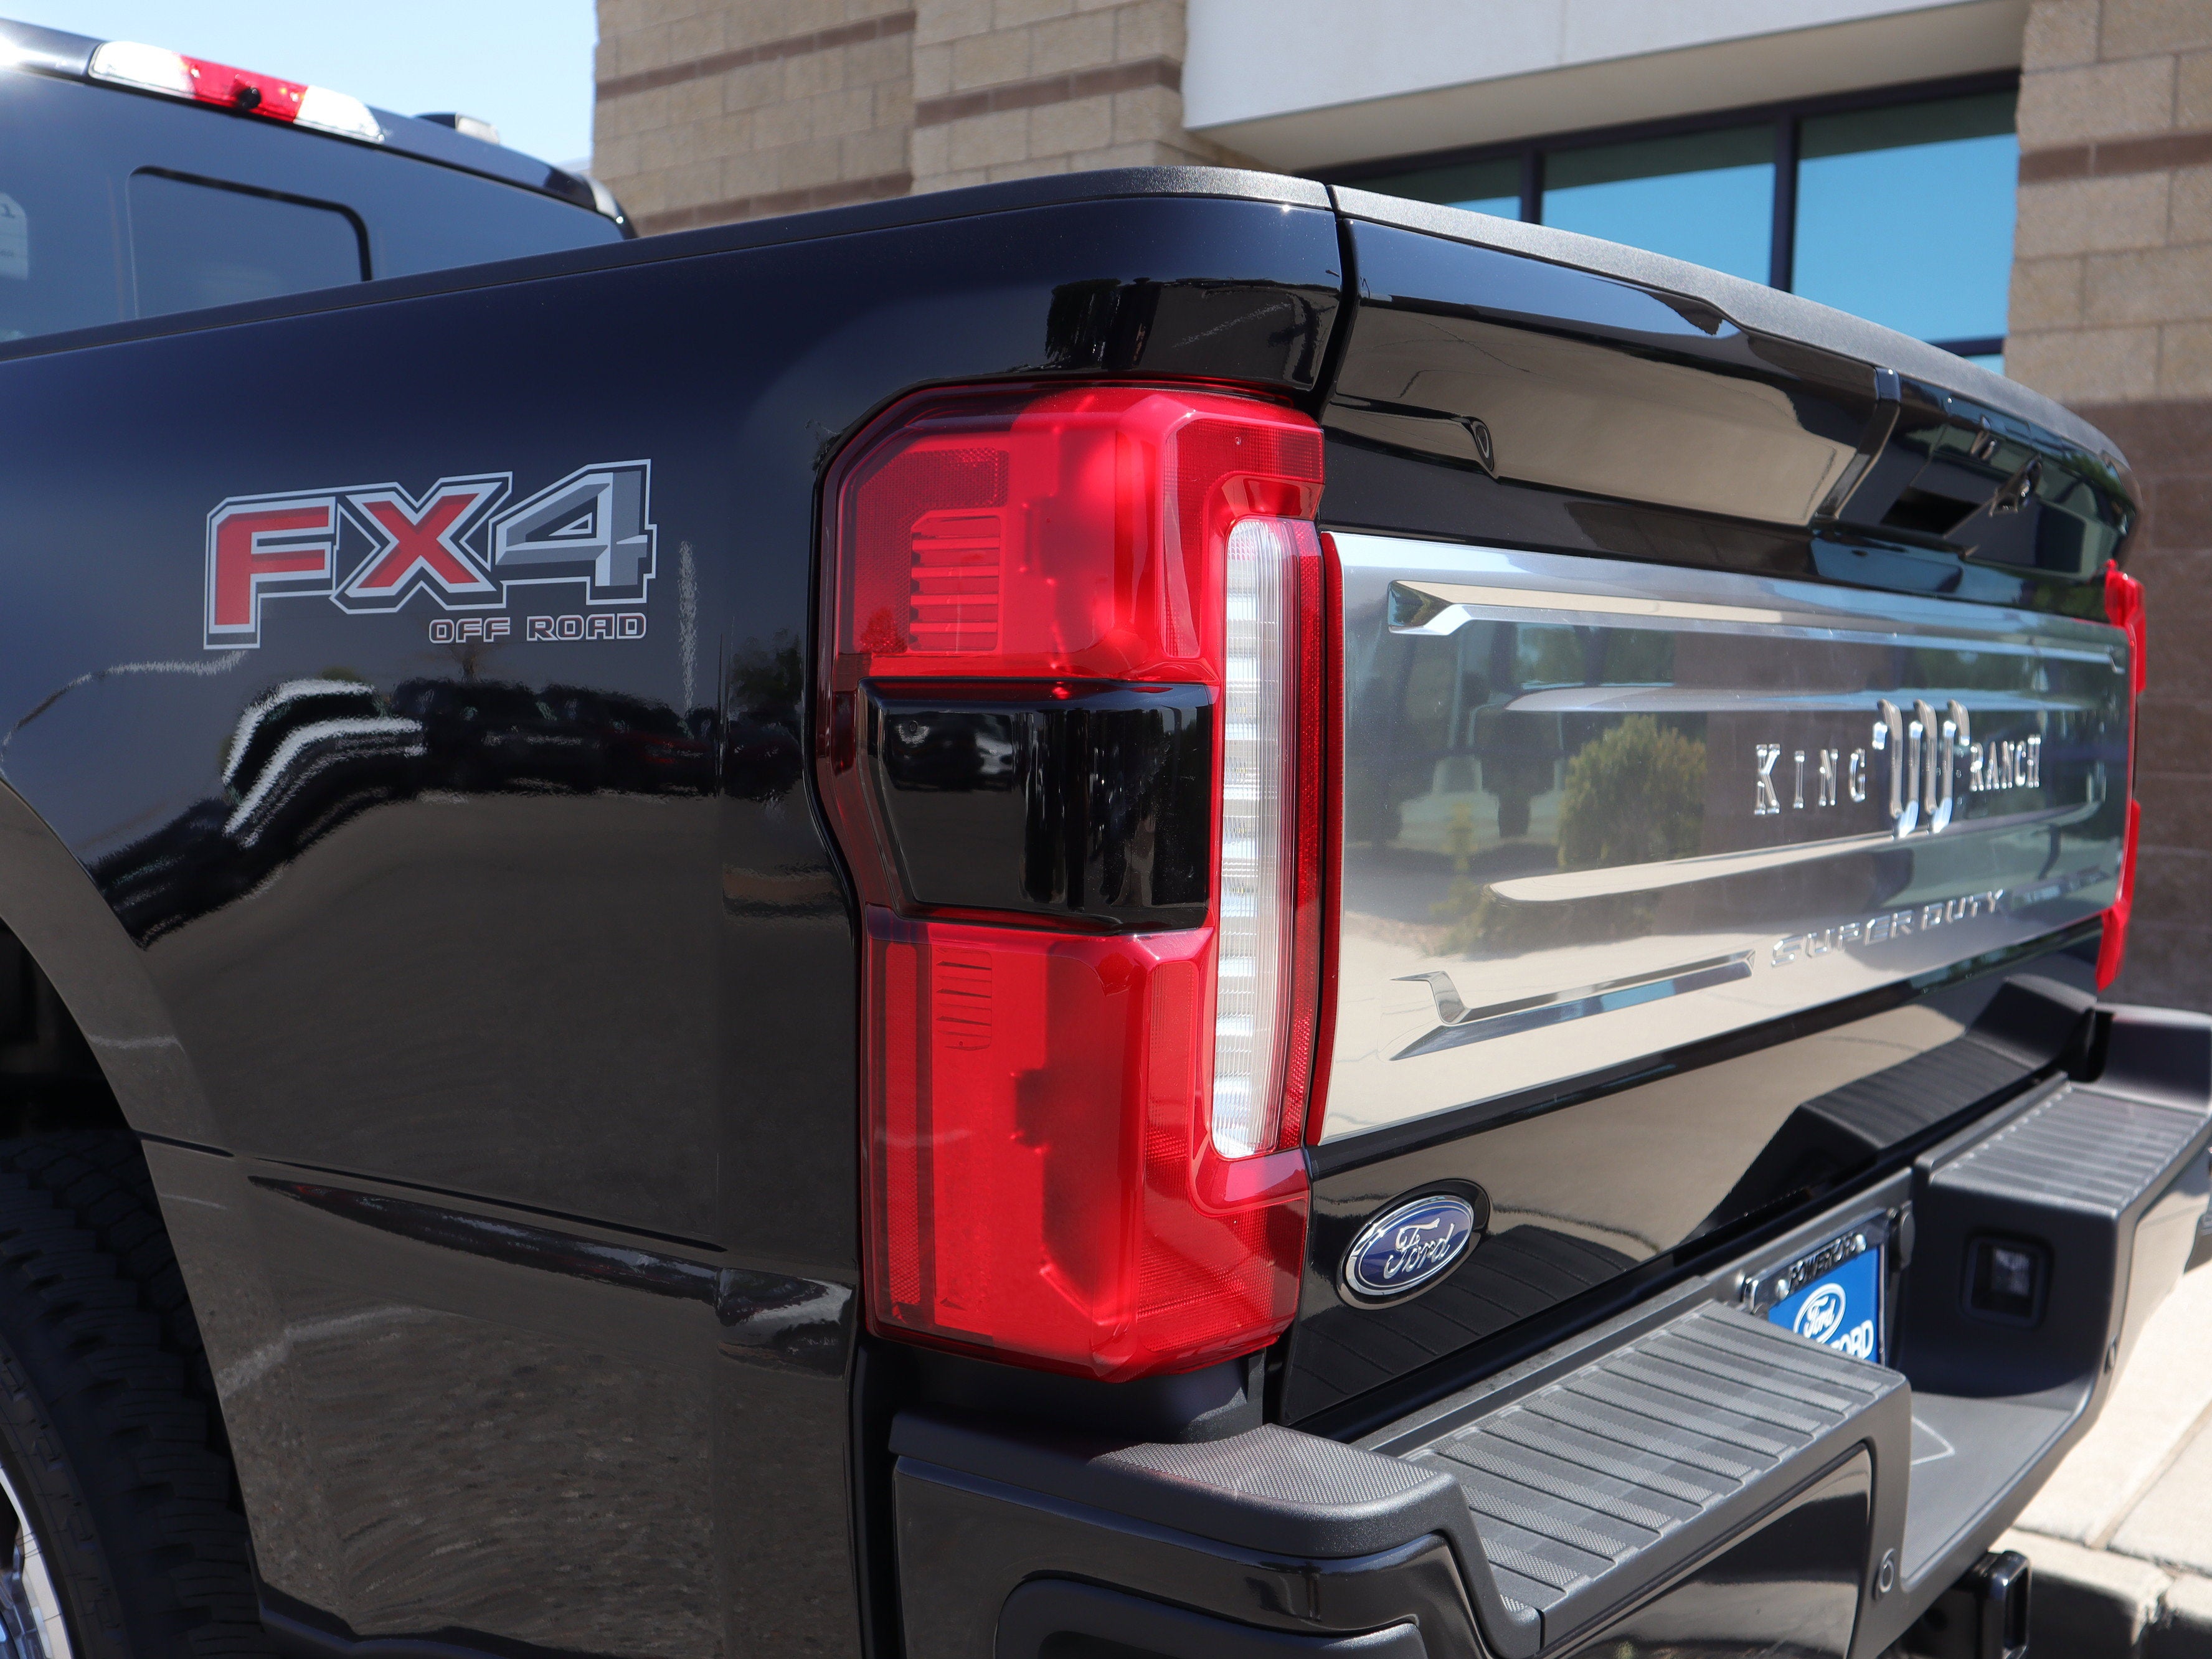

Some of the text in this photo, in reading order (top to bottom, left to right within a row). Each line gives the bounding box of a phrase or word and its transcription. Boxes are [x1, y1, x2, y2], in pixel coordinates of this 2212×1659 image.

[204, 458, 658, 650] FX4
[428, 612, 647, 644] OFF ROAD
[1754, 734, 2041, 815] KING RANCH
[1771, 889, 2005, 969] SUPER DUTY
[1383, 1217, 1455, 1280] Ford
[1803, 1295, 1836, 1339] Ford
[1830, 1319, 1874, 1360] ORD
